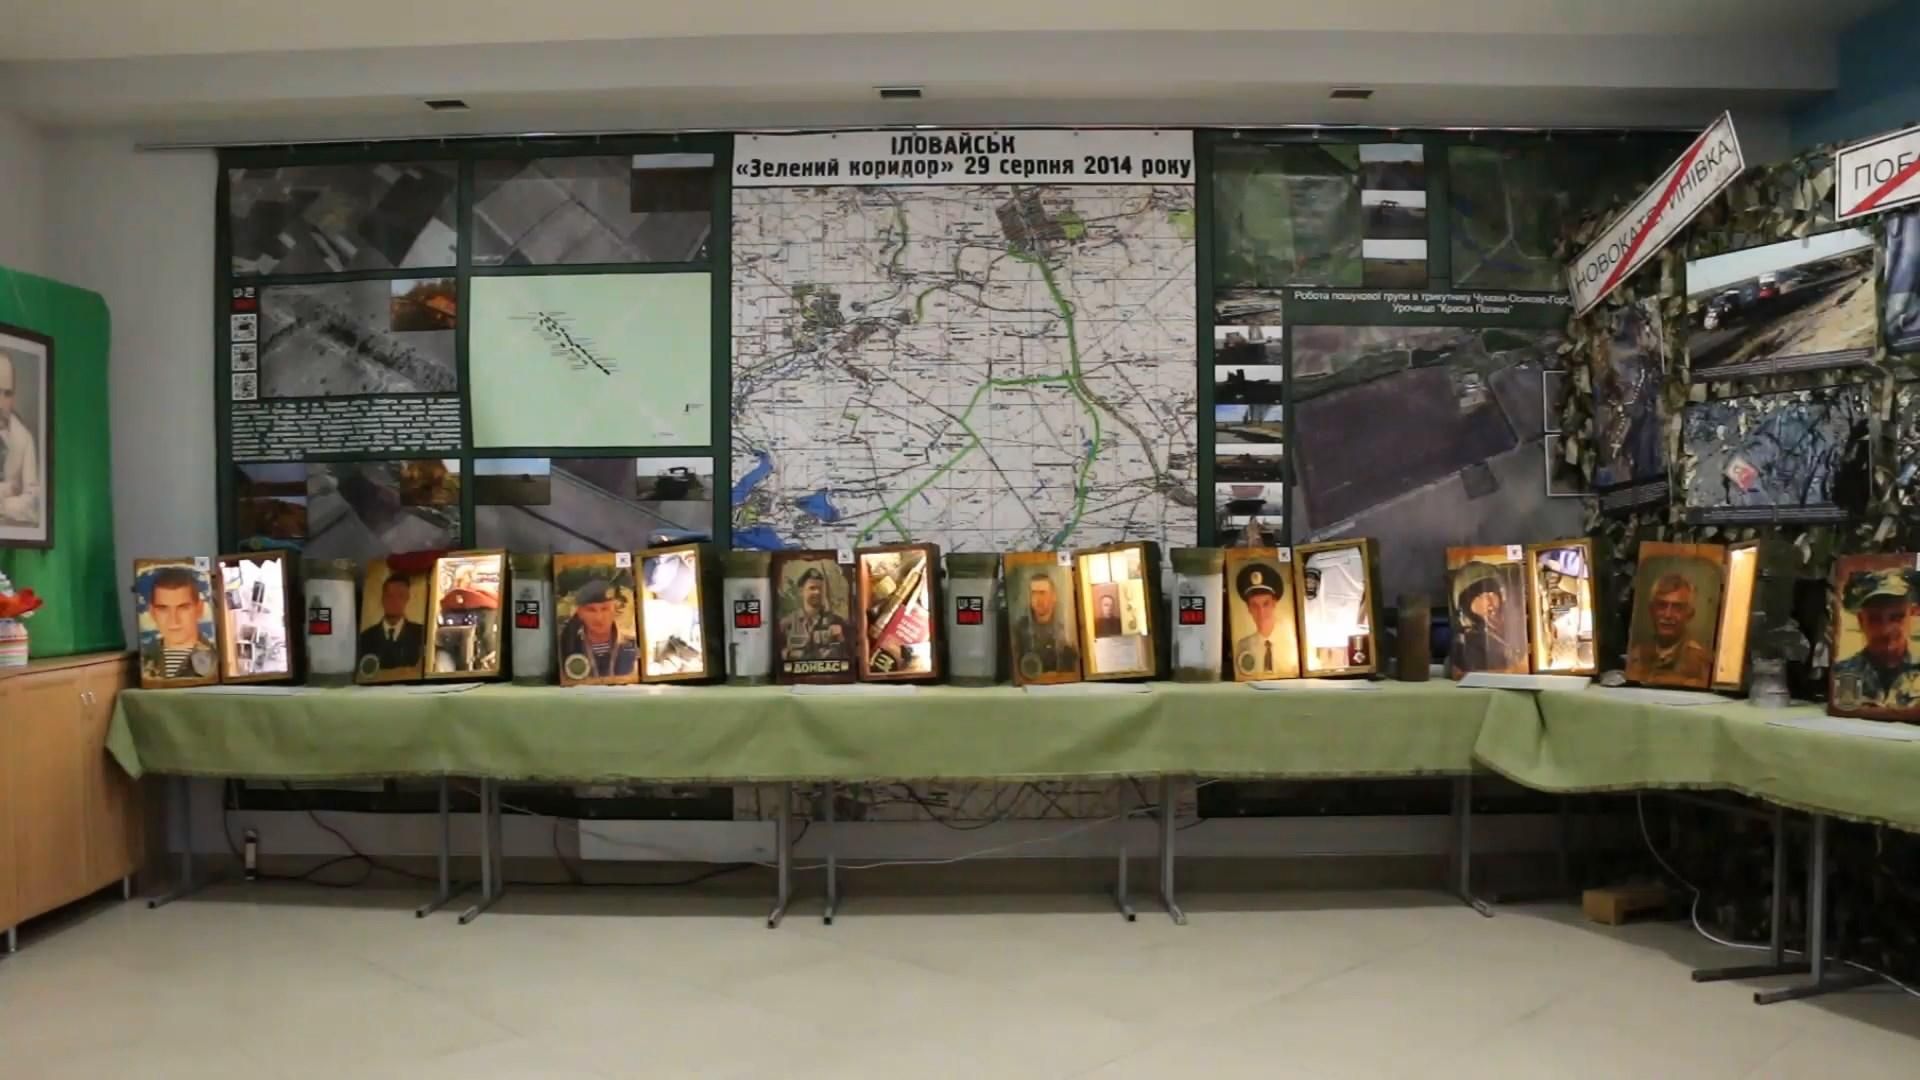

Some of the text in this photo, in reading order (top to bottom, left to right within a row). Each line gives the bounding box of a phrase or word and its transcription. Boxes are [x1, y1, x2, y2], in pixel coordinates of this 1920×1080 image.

[892, 133, 1016, 155] ІЛОВАЙСЬК
[736, 155, 1192, 179] «Зелений коридор» 29 серпня 2014 року
[1294, 290, 1329, 301] Робота
[793, 661, 843, 674] ДОНБАС
